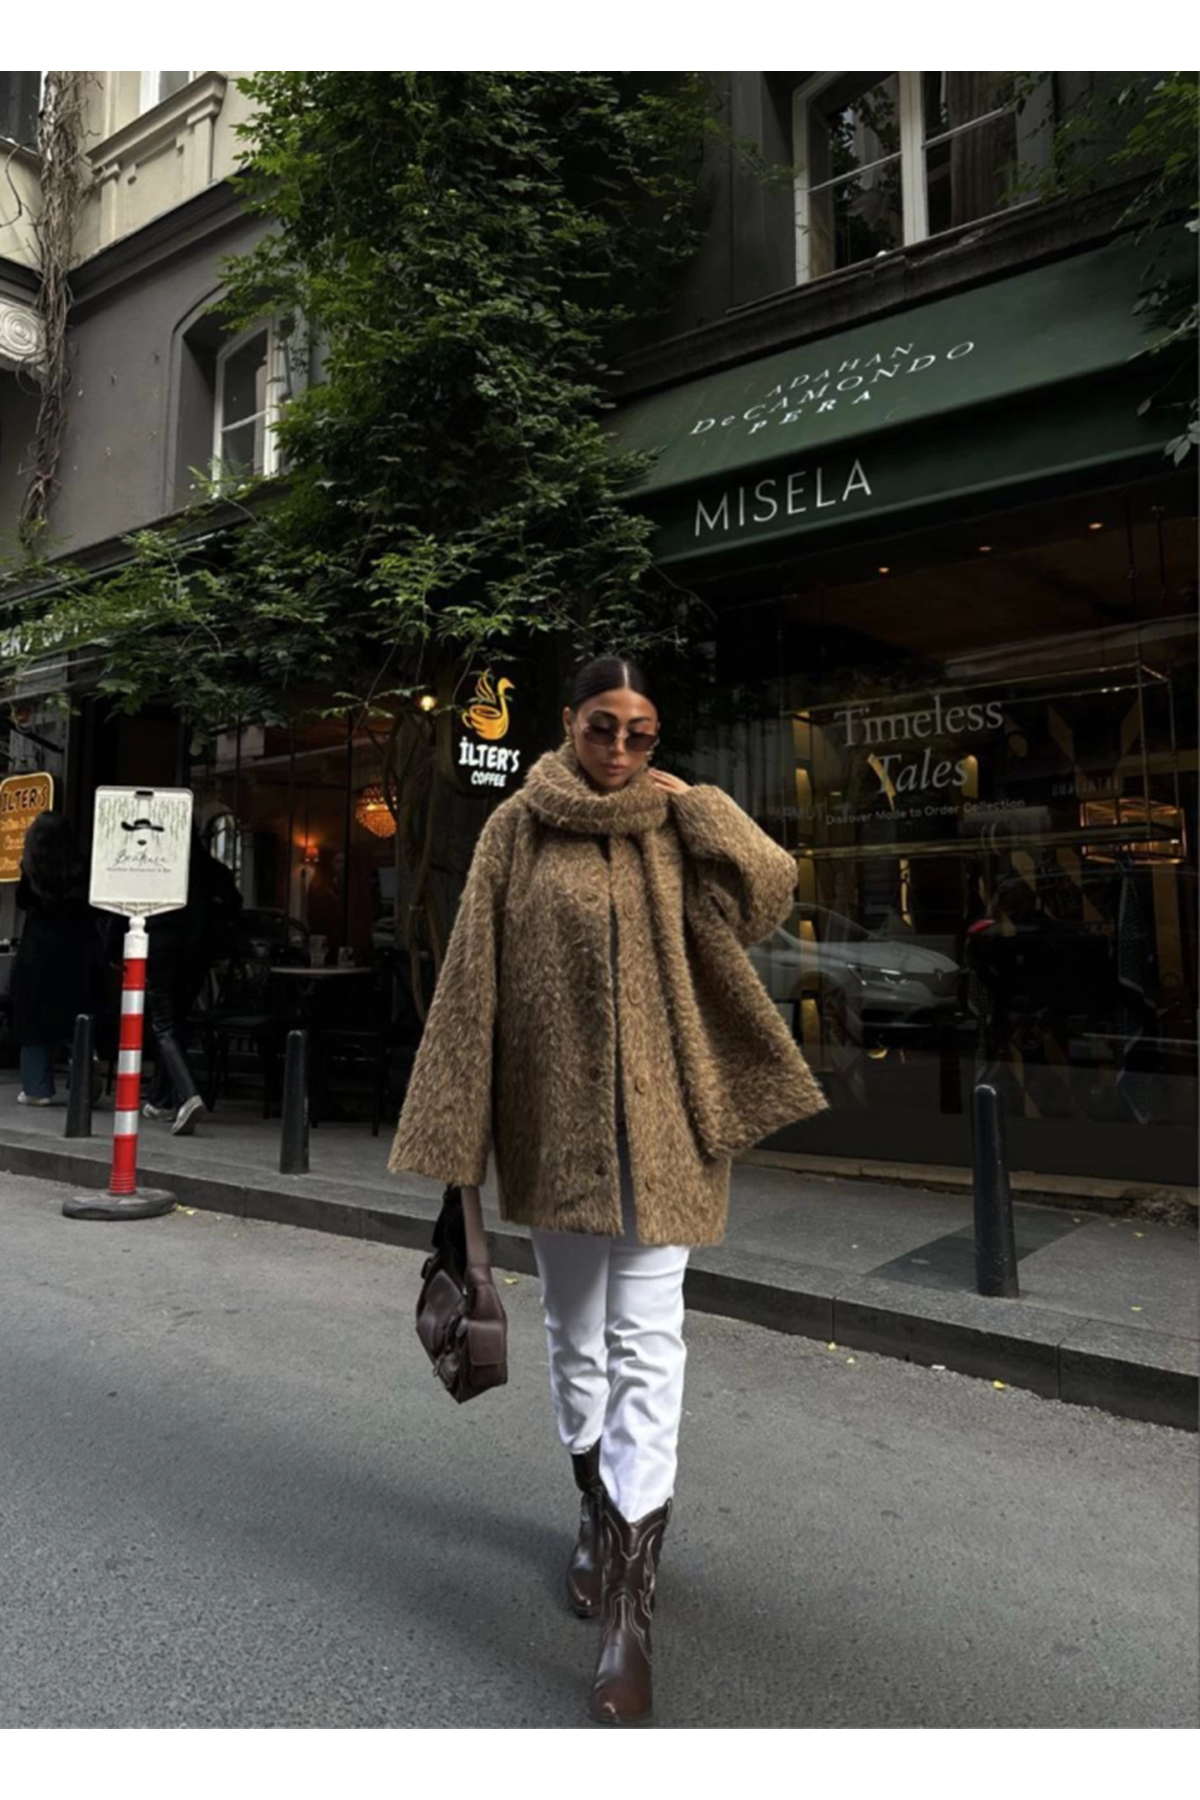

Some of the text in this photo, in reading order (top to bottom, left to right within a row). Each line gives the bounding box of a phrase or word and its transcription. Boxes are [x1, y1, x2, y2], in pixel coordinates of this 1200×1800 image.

[765, 343, 914, 398] ADAHAN
[748, 390, 872, 435] PERA
[694, 457, 872, 537] MISELA
[832, 693, 1005, 748] Timeless
[470, 769, 508, 789] COFFEE
[874, 746, 969, 796] Tales
[825, 810, 873, 826] Discover
[909, 806, 923, 818] to
[924, 802, 961, 818] Order
[962, 797, 1027, 814] Collection
